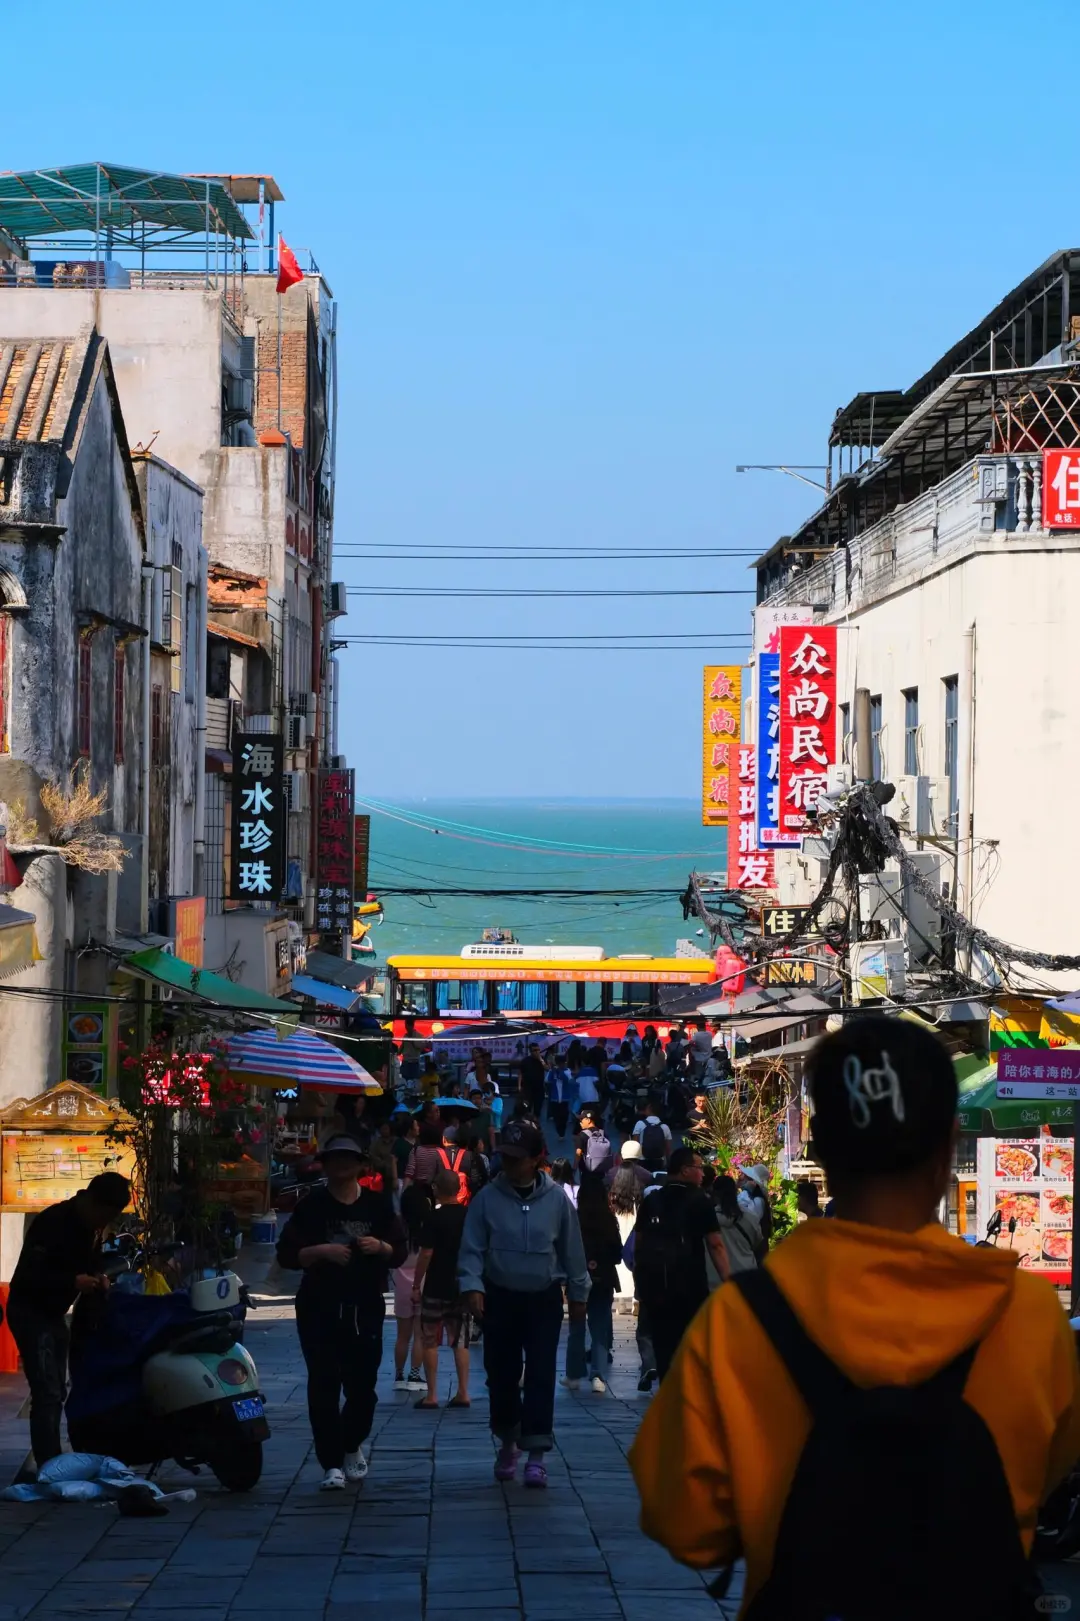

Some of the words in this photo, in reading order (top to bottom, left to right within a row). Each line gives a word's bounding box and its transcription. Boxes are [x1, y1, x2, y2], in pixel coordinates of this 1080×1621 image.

[786, 632, 831, 809] 众尚民宿
[239, 743, 275, 894] 海水珍珠
[1002, 1052, 1012, 1062] 北
[1006, 1087, 1013, 1095] N
[1021, 1171, 1033, 1183] 12
